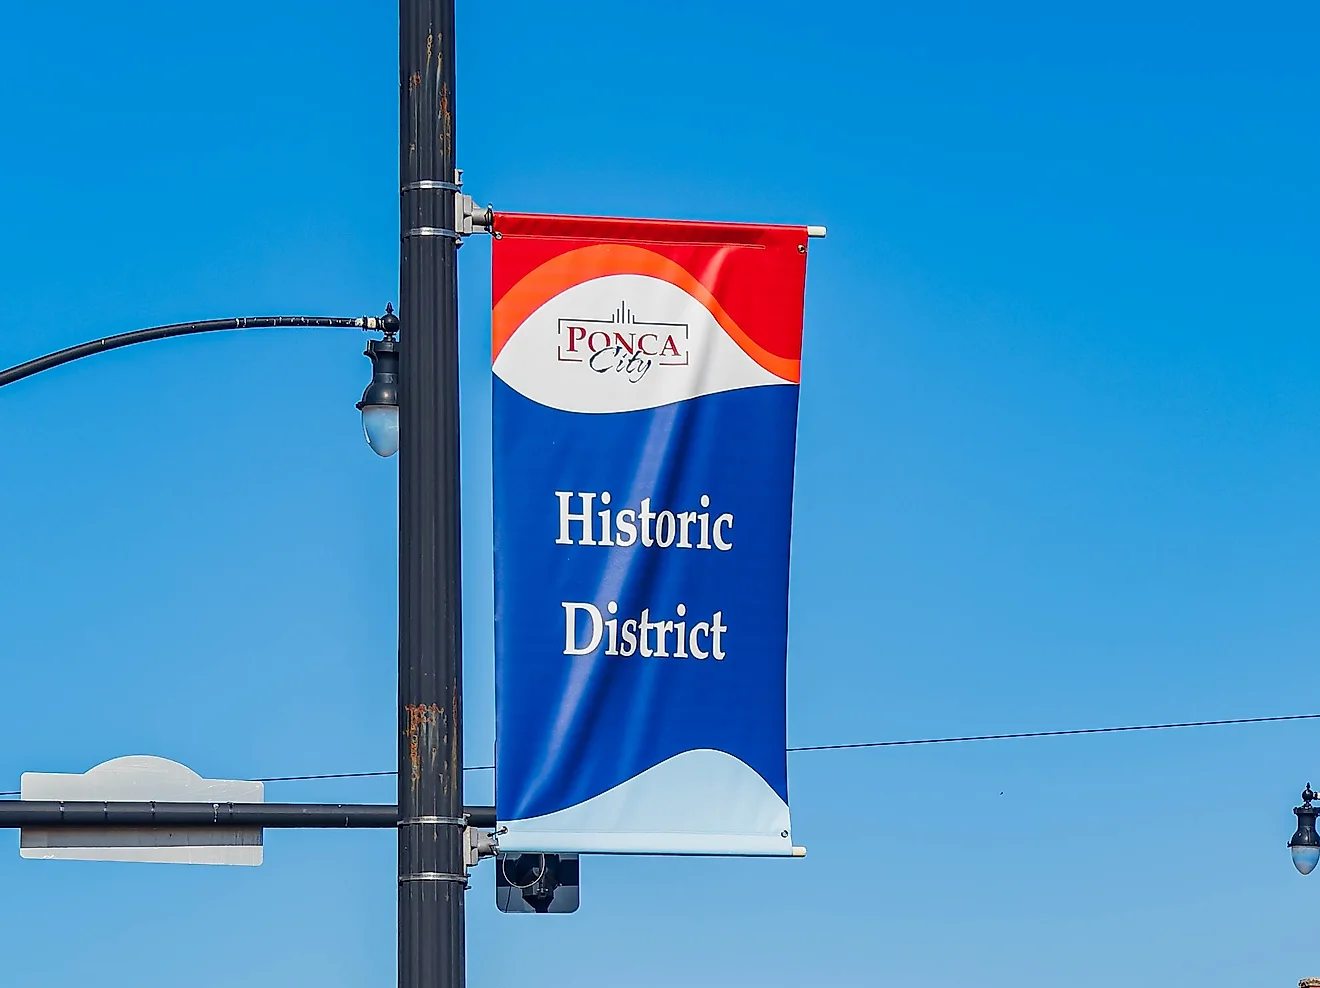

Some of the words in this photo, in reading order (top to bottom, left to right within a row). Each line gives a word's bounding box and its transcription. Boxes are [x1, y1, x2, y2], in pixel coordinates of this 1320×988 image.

[566, 326, 681, 356] PONCA
[589, 346, 652, 383] City
[554, 490, 734, 551] Historic
[561, 600, 728, 661] District
